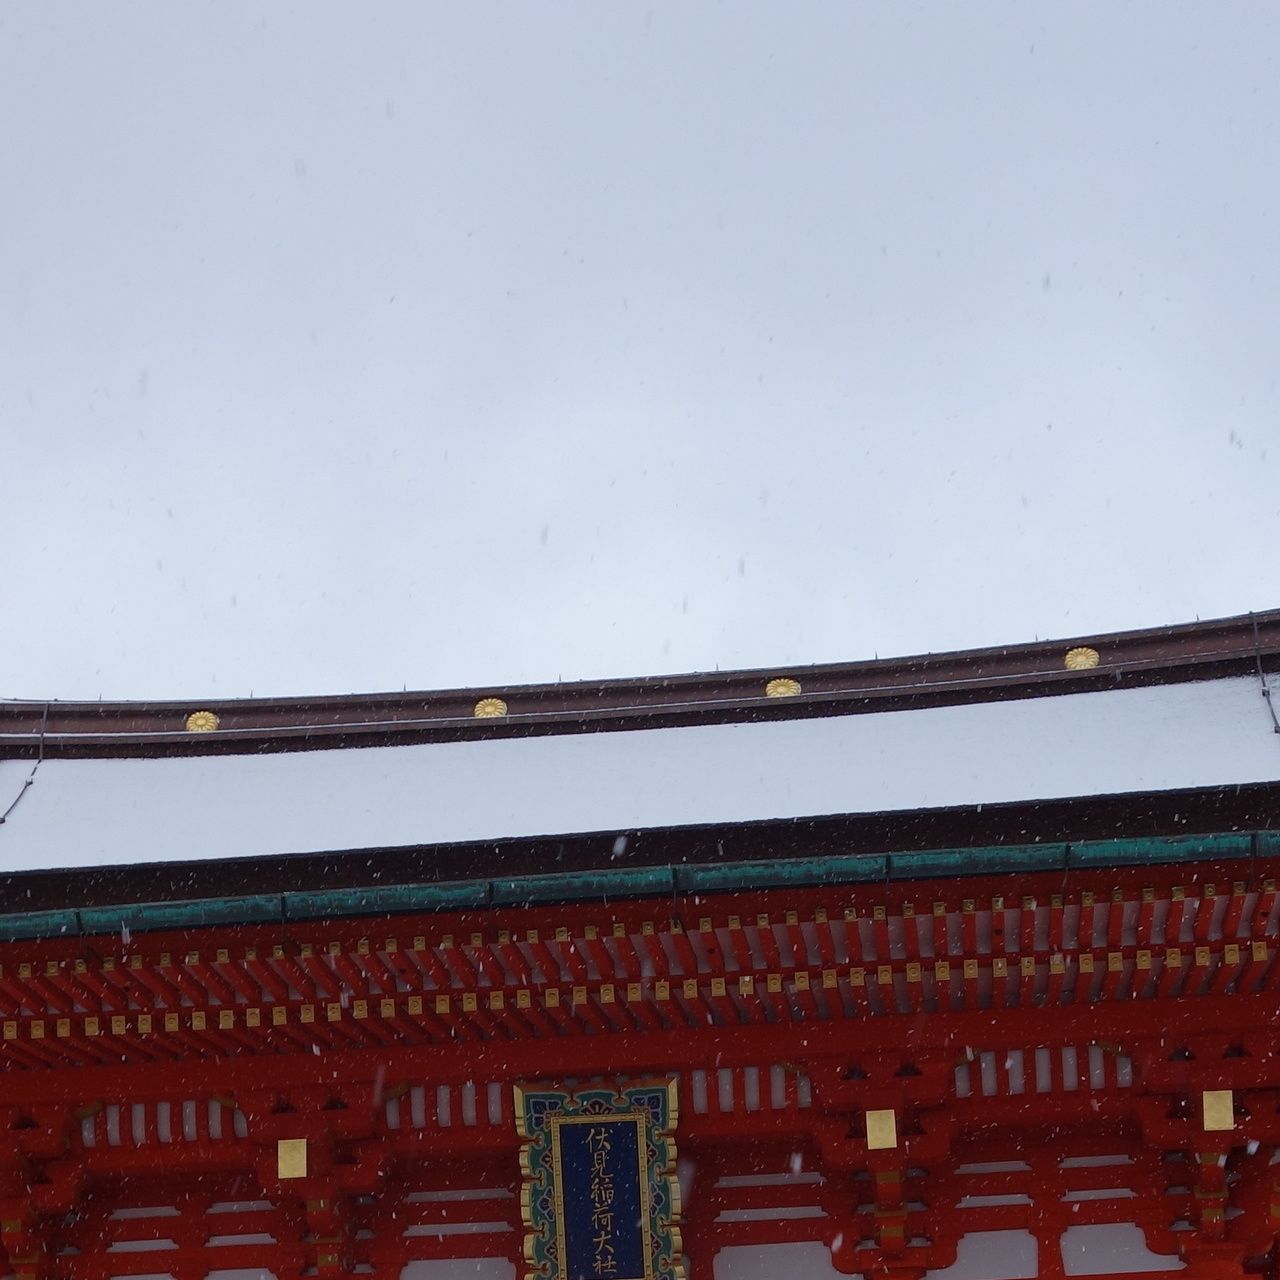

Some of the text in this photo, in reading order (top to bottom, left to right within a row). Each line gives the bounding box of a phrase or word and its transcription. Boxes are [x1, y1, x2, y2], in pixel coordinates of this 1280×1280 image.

[585, 1126, 618, 1276] 伏見稲荷大社
